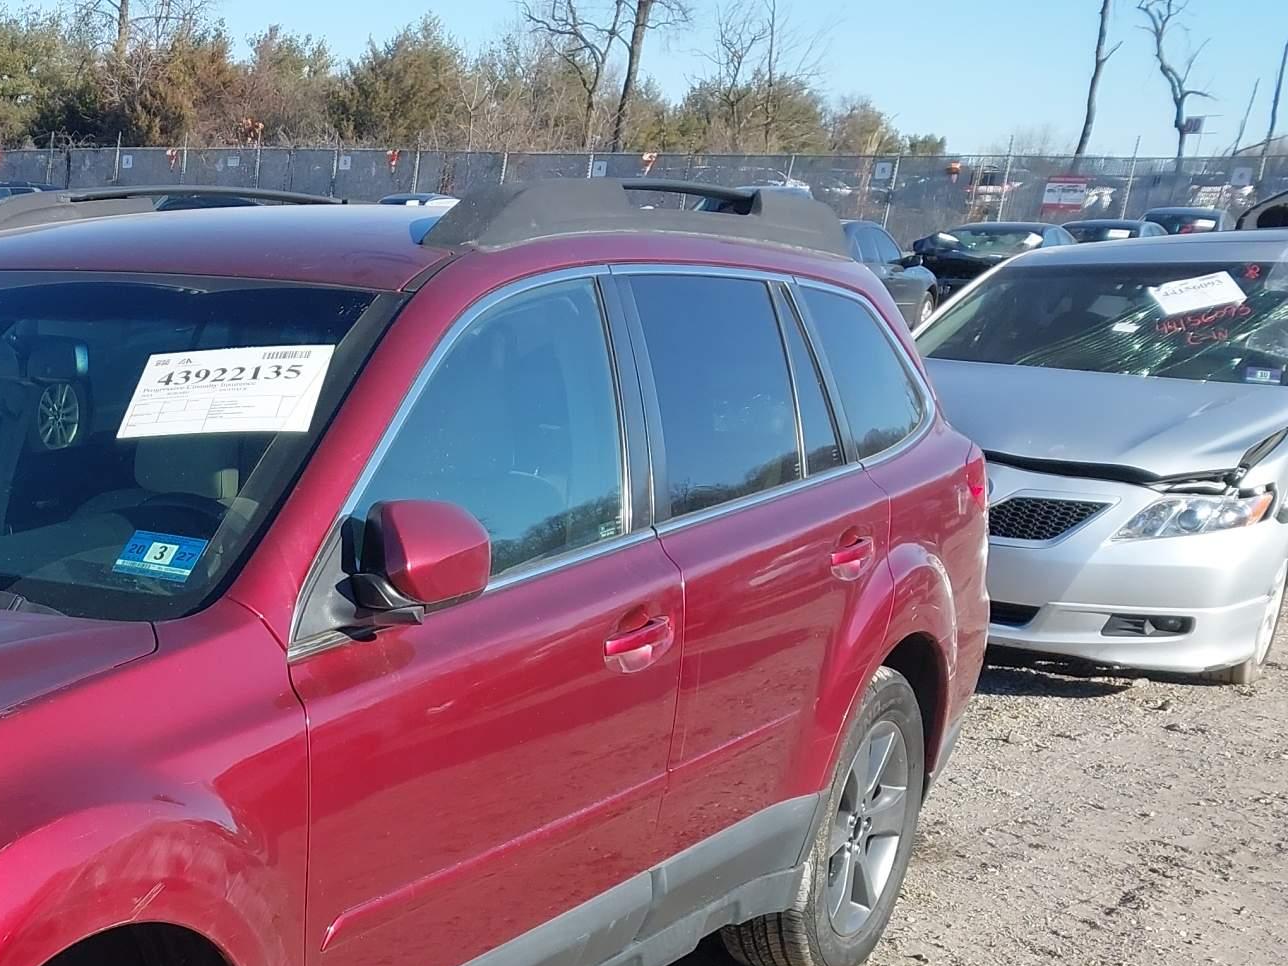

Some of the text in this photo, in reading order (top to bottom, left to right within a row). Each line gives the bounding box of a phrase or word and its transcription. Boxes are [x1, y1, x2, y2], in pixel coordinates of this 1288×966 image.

[158, 365, 303, 385] 43922135
[128, 544, 195, 561] 20 3 27
